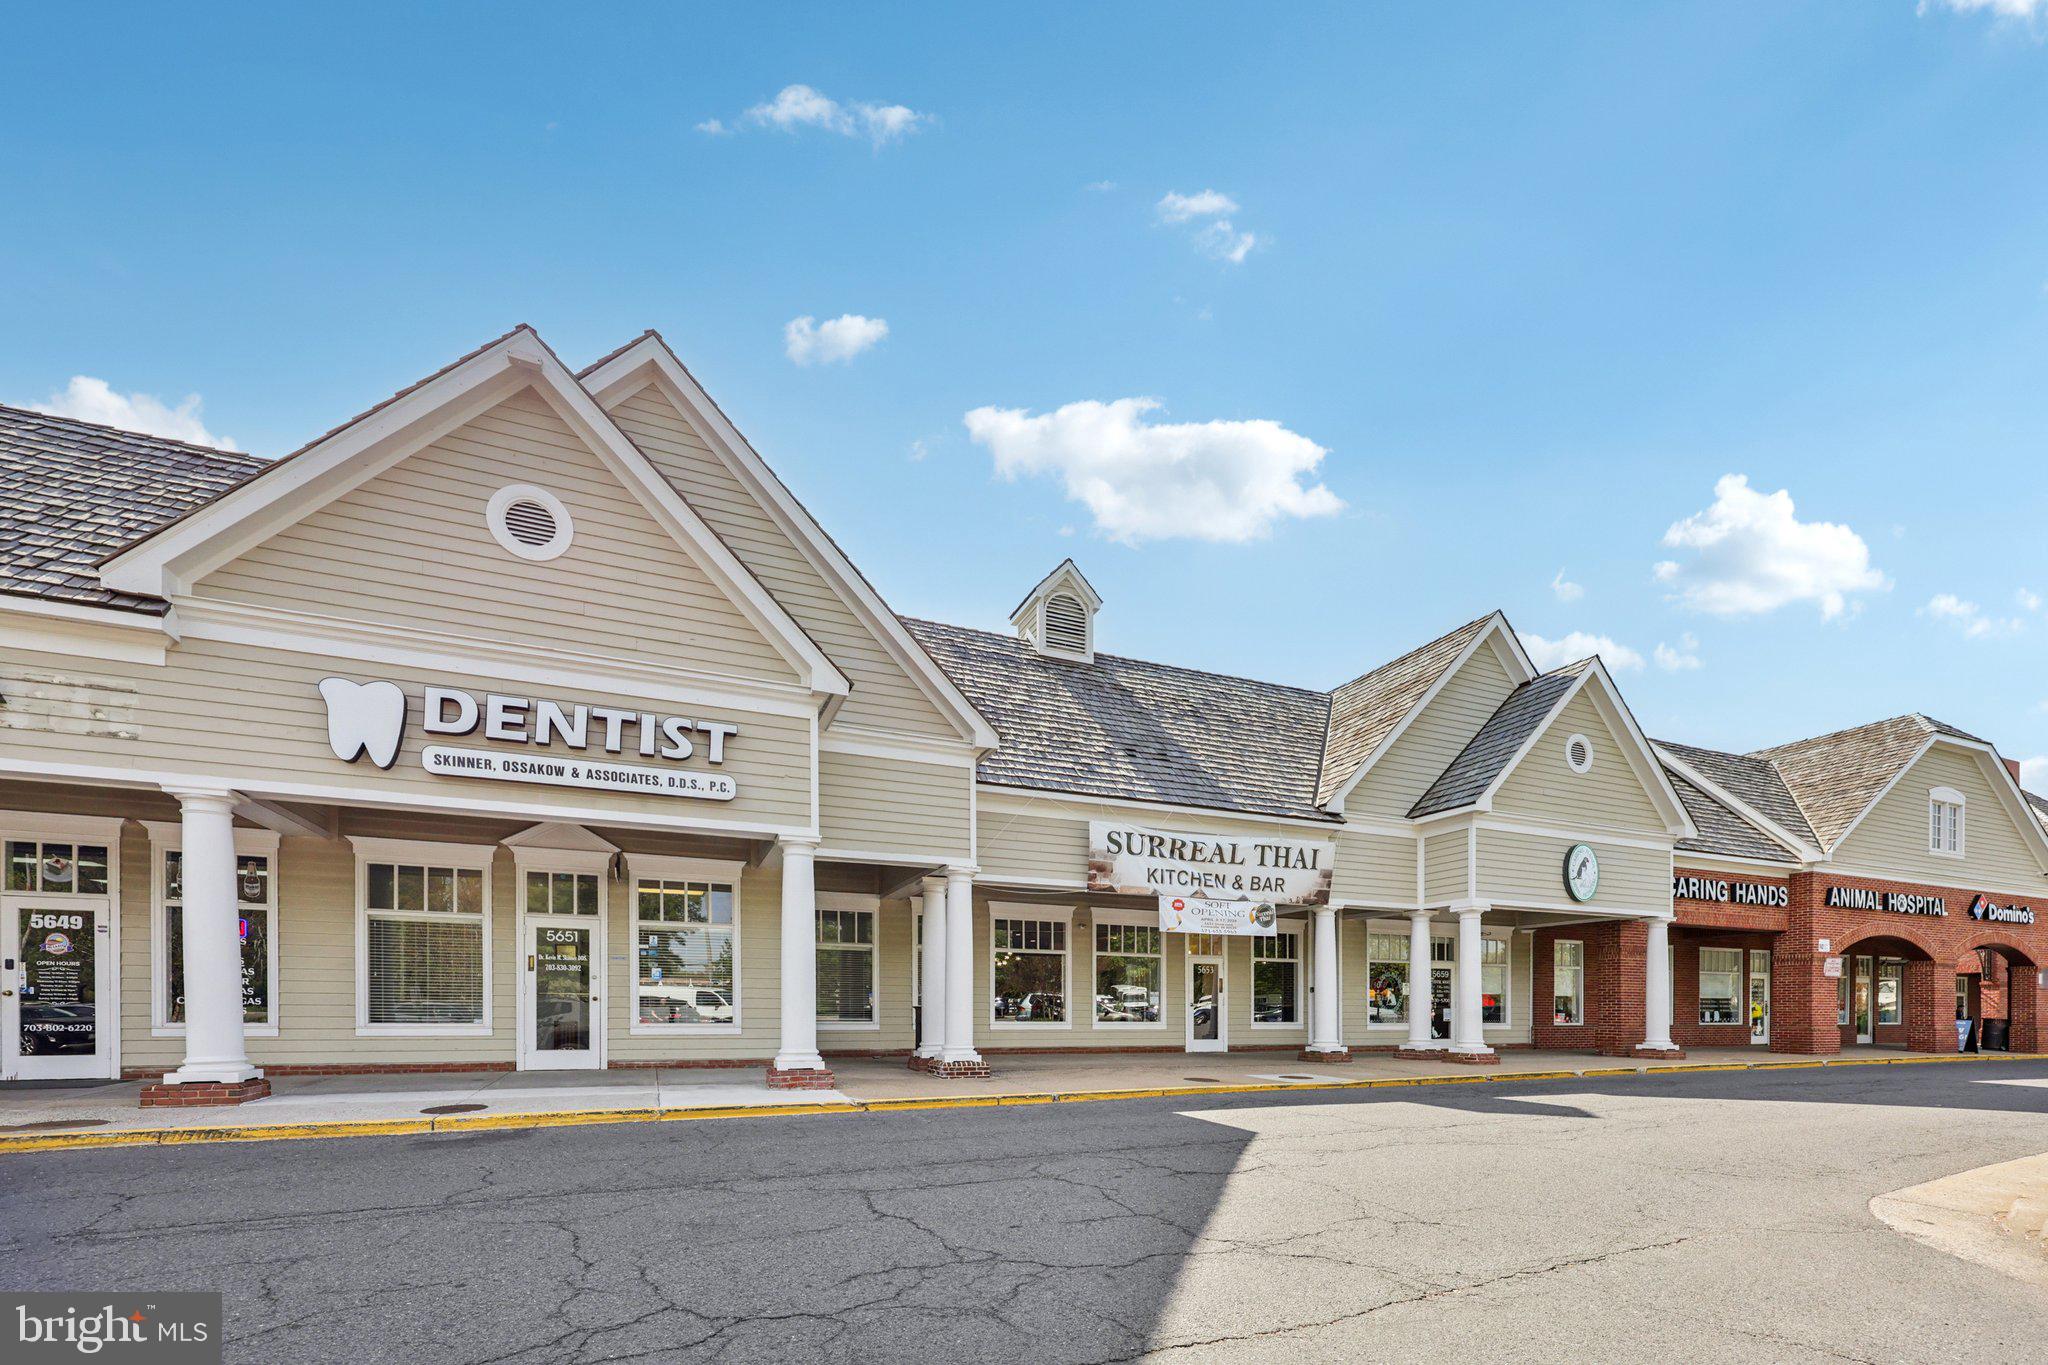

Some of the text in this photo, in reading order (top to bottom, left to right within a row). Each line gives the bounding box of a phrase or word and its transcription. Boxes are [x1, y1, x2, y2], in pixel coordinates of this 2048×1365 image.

[424, 686, 738, 765] DENTIST
[433, 753, 497, 772] SKINNER,
[502, 760, 565, 778] OSSAKOW
[571, 767, 580, 779] &
[586, 768, 663, 787] ASSOCIATES,
[709, 780, 730, 793] P.C.
[1106, 831, 1320, 870] SURREAL THAI
[1147, 868, 1285, 893] KITCHEN & BAR
[1735, 882, 1788, 907] HANDS
[1830, 886, 1949, 916] ANIMAL HOSPITAL
[1191, 907, 1246, 918] OPENING
[1204, 901, 1232, 910] SOFT
[1988, 904, 2035, 925] Domino's
[30, 914, 83, 930] 5649
[546, 930, 579, 942] 5651
[1197, 966, 1214, 974] 5653
[23, 1024, 93, 1032] 703-802-6220
